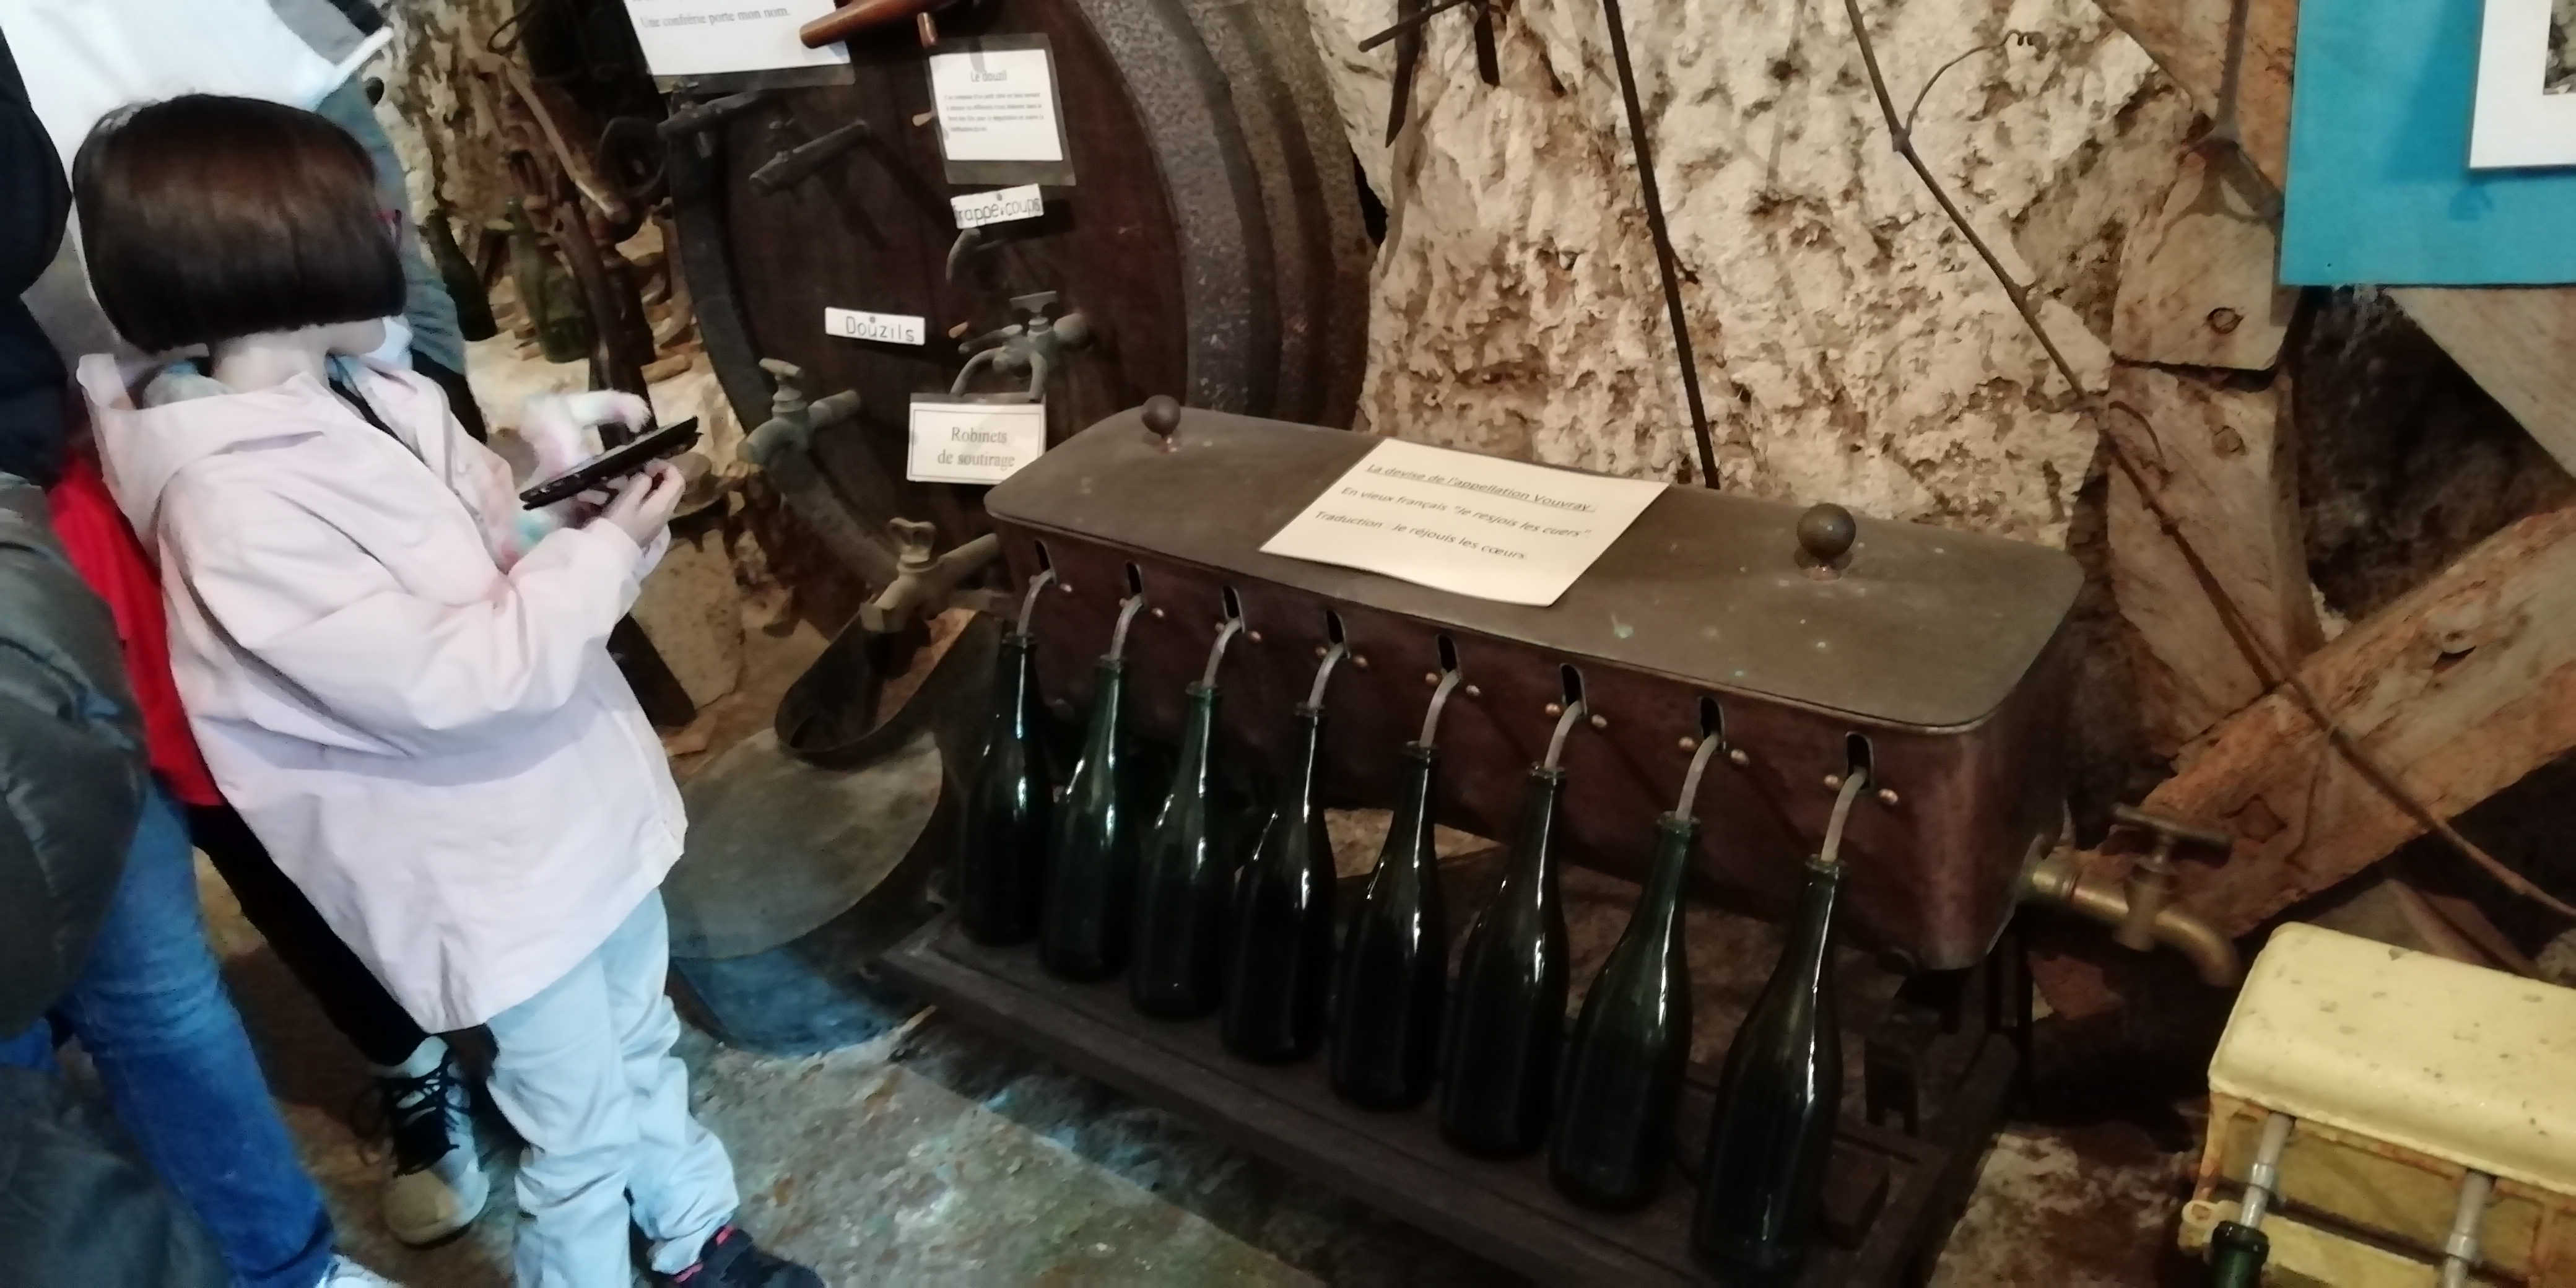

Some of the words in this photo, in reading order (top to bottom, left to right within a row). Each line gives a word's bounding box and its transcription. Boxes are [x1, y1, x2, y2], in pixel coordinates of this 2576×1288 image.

[640, 17, 660, 28] Une
[708, 12, 735, 26] porte
[738, 11, 761, 21] mon
[970, 71, 980, 82] Le
[846, 315, 915, 342] Douzils
[951, 426, 1007, 444] Robinets
[937, 449, 954, 464] de
[957, 453, 1016, 471] soutirage
[1366, 463, 1383, 474] La
[1385, 468, 1426, 481] devise
[1427, 474, 1445, 485] de
[1447, 476, 1531, 500] l'appellation
[1534, 494, 1591, 512] Vouvray
[1341, 487, 1358, 496] En
[1360, 491, 1395, 503] vieux
[1396, 496, 1448, 511] français
[1519, 521, 1541, 532] les
[1315, 510, 1383, 528] Traduction
[1391, 523, 1408, 532] Je
[1409, 527, 1457, 544] réjouis
[1458, 536, 1479, 549] les
